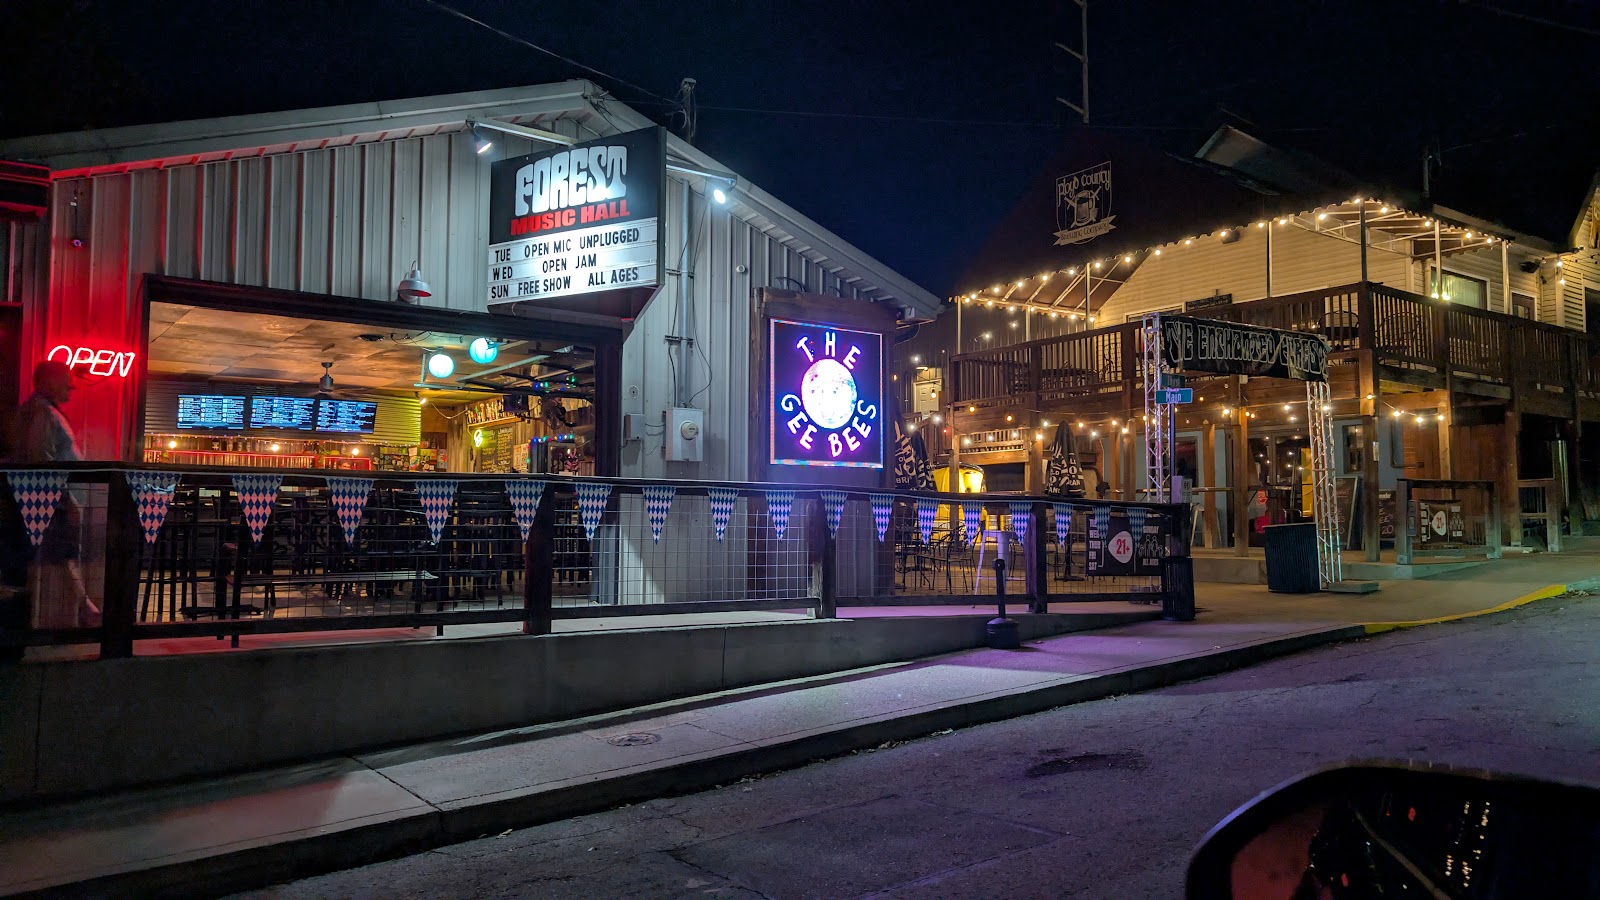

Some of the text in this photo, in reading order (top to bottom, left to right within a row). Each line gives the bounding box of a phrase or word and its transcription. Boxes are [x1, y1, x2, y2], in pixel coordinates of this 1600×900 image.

[515, 145, 627, 217] FOREST
[511, 200, 630, 236] MUSIC HALL
[495, 228, 640, 263] TUE OPEN MIC UNPLUGGED
[491, 267, 638, 299] SUN FREE SHOW ALL AGES
[493, 253, 597, 280] WED OPEN JAM
[47, 345, 136, 378] OPEN
[796, 331, 861, 370] THE
[1165, 391, 1182, 402] Main
[781, 394, 877, 457] GEE BEES
[1116, 538, 1130, 555] 21+
